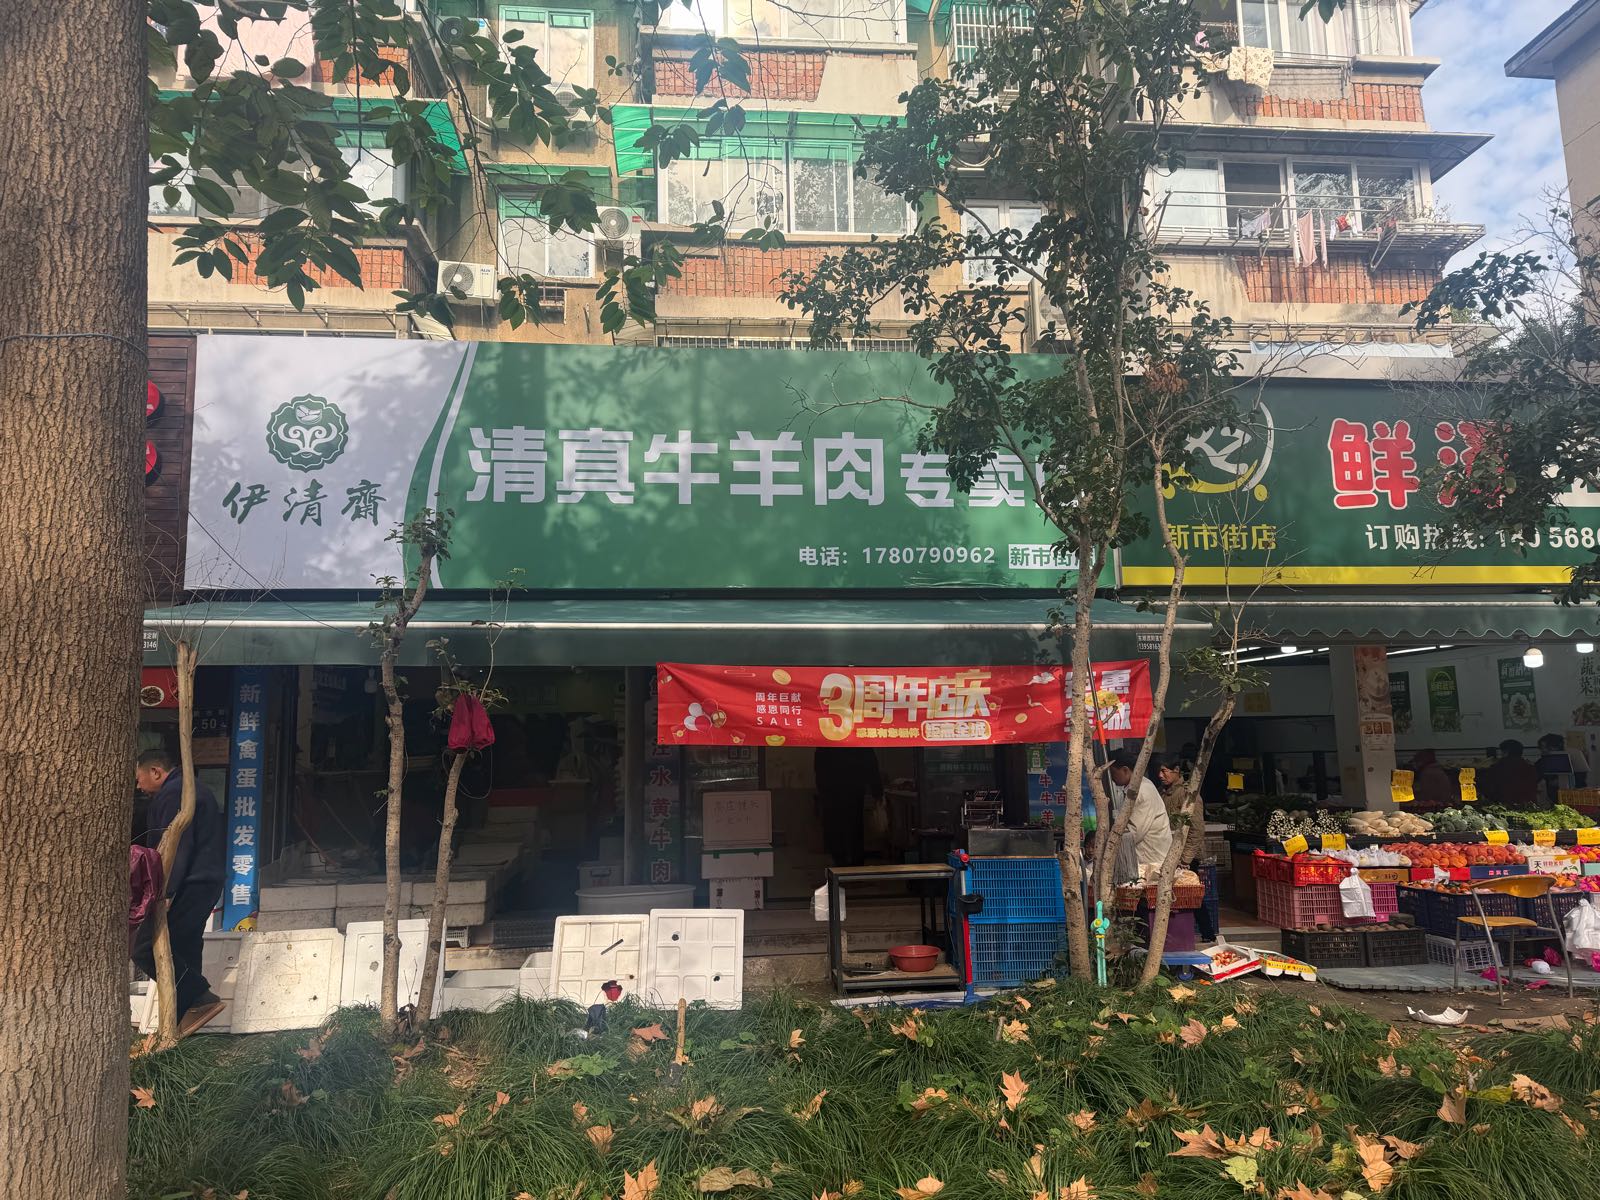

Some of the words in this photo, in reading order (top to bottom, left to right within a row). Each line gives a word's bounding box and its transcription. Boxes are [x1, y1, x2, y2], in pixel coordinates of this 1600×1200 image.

[467, 426, 1079, 508] 清真牛羊肉专卖
[1163, 523, 1278, 551] 新市街店
[862, 547, 996, 564] 1780790962
[755, 692, 802, 702] 周年巨献
[818, 670, 992, 741] 3周年店庆
[756, 705, 802, 715] 感恩同行
[757, 716, 803, 726] SALE
[230, 683, 261, 906] 新鲜禽蛋批发零售
